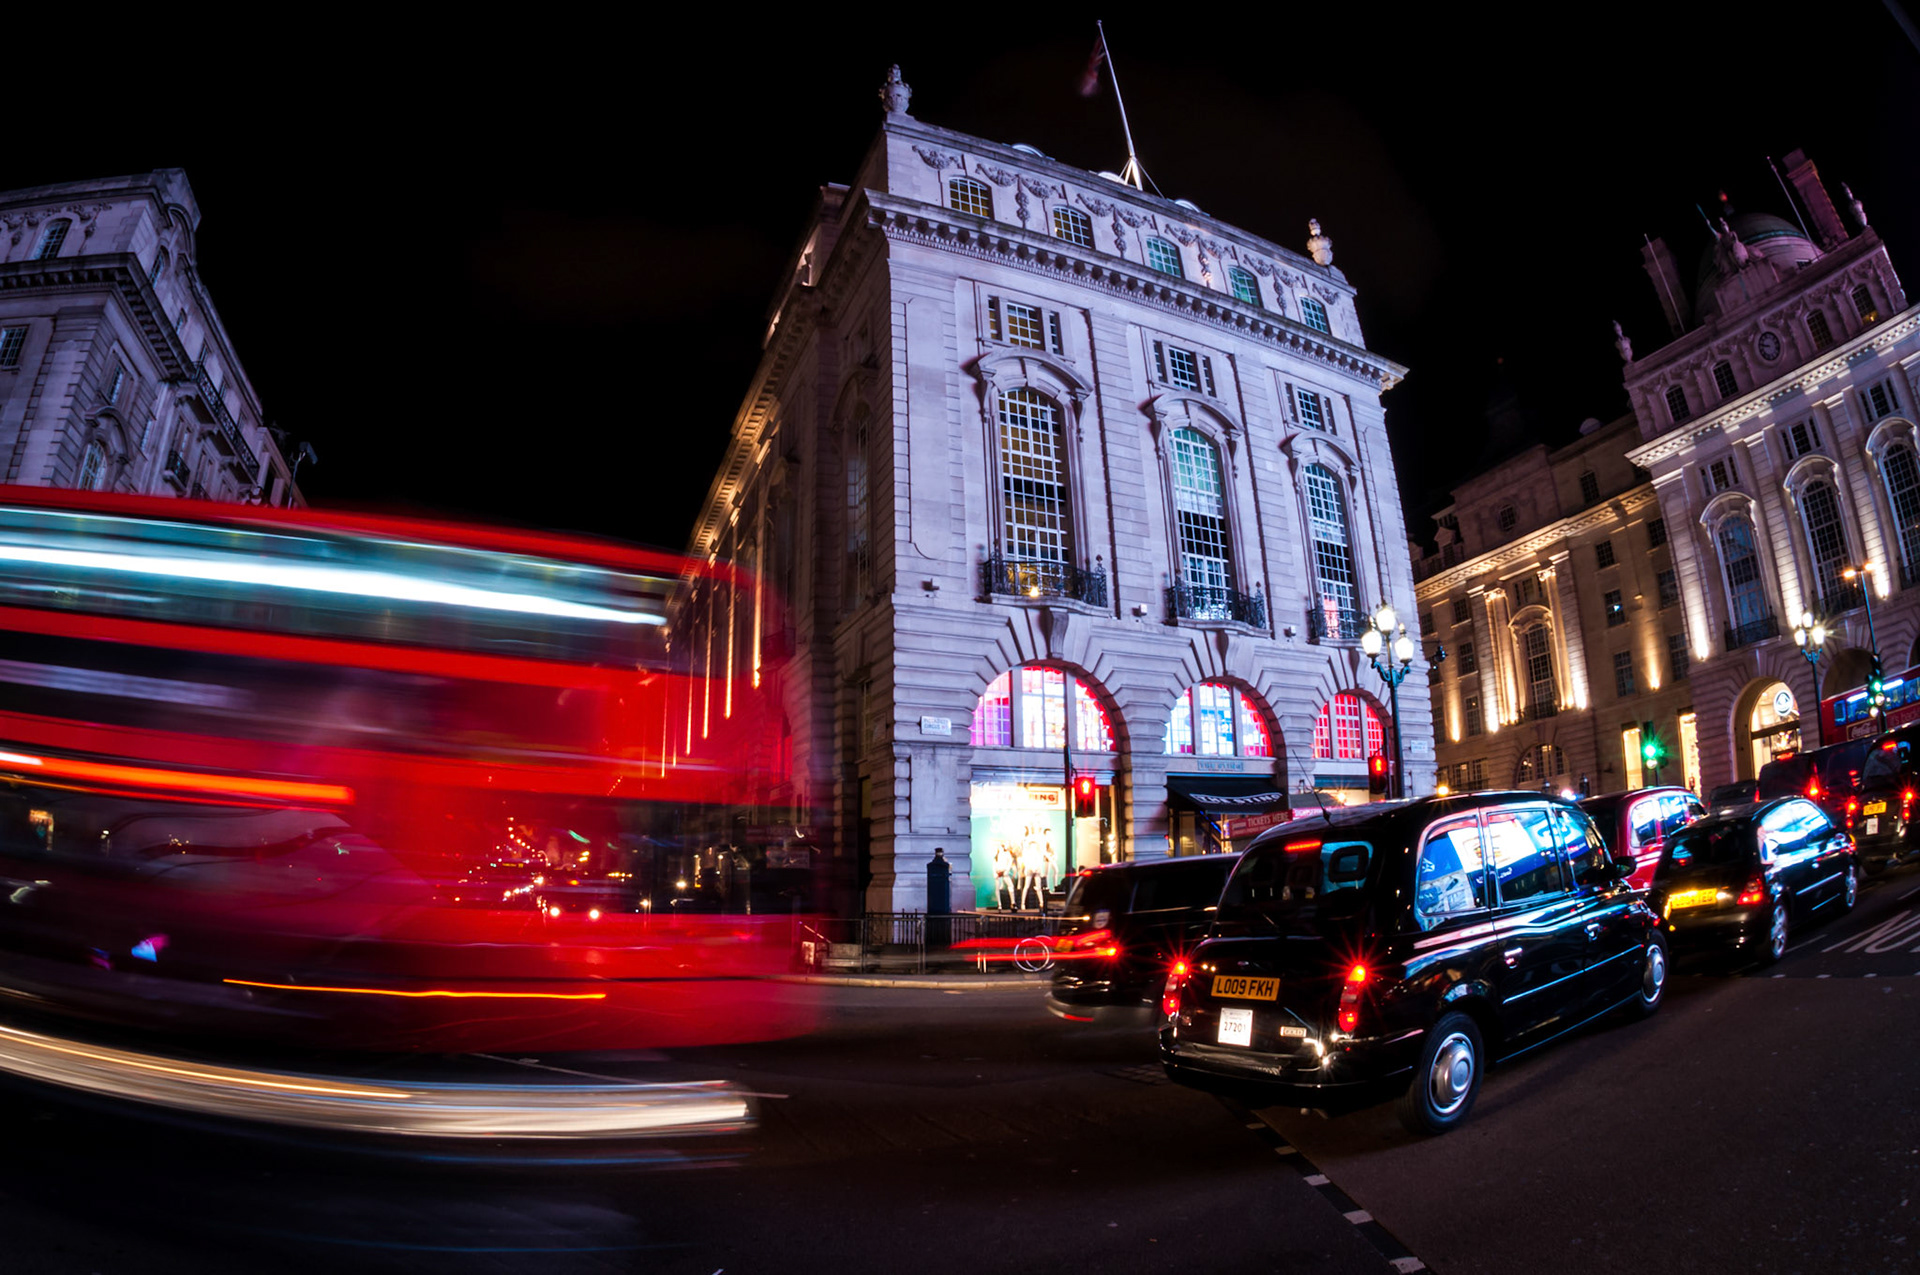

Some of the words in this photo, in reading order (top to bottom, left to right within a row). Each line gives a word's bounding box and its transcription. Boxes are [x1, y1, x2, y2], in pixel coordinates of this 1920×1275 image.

[1248, 815, 1271, 828] TICKETS
[1272, 811, 1289, 822] HERE
[1216, 978, 1246, 995] LO09
[1248, 980, 1274, 997] FKH
